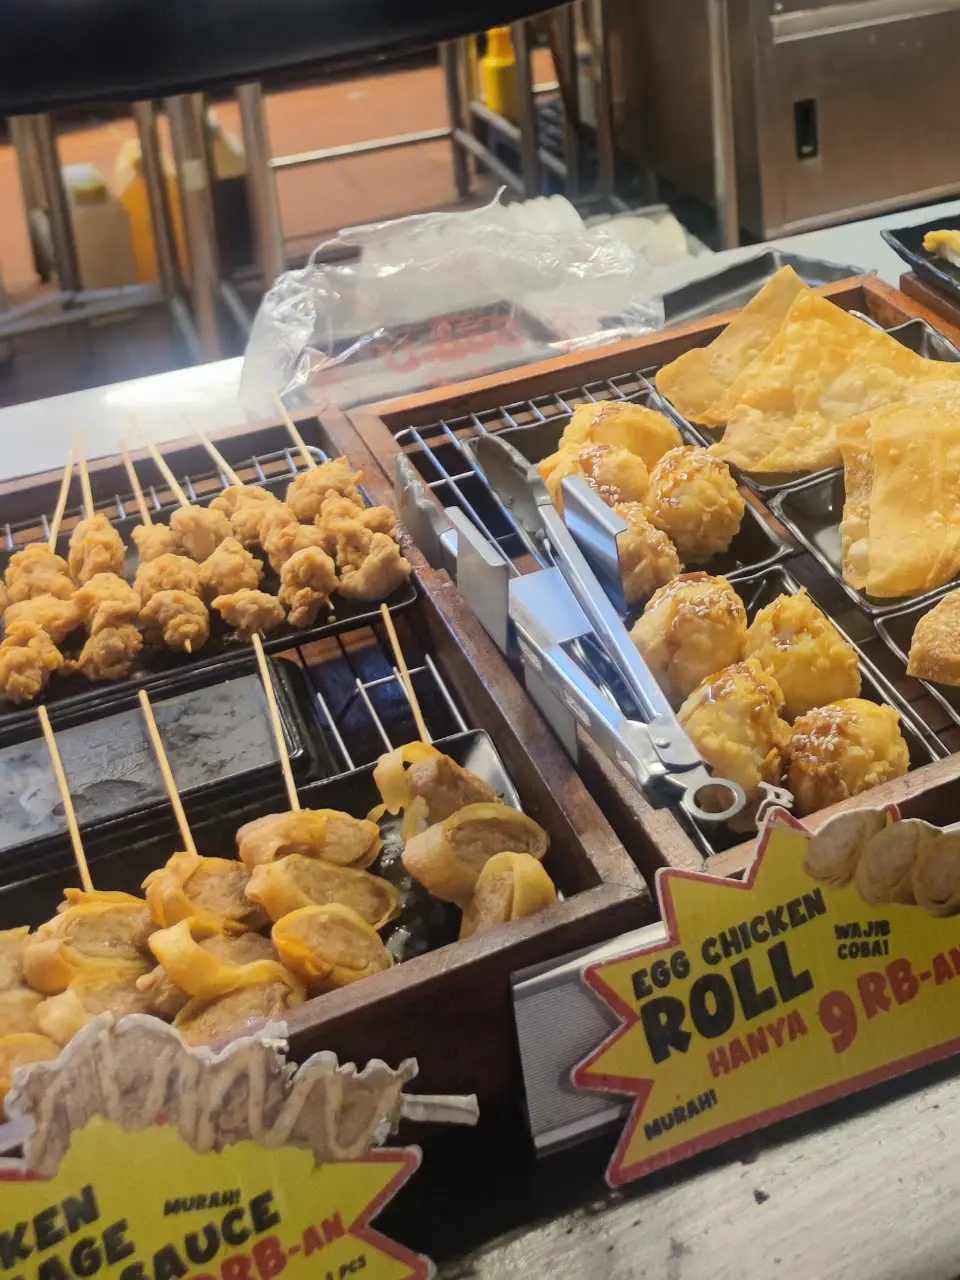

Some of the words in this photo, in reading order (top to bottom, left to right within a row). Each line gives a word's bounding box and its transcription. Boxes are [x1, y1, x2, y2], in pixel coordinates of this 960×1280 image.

[632, 950, 690, 1000] EGG
[702, 888, 827, 965] CHICKEN
[834, 920, 890, 939] WAJIB
[838, 939, 889, 960] COBA!
[640, 941, 814, 1064] ROLL
[707, 1010, 808, 1078] HANYA
[819, 990, 857, 1054] 9
[644, 1088, 718, 1141] MURAH!
[119, 1189, 281, 1280] SAUCE
[164, 1188, 241, 1216] MURAH!
